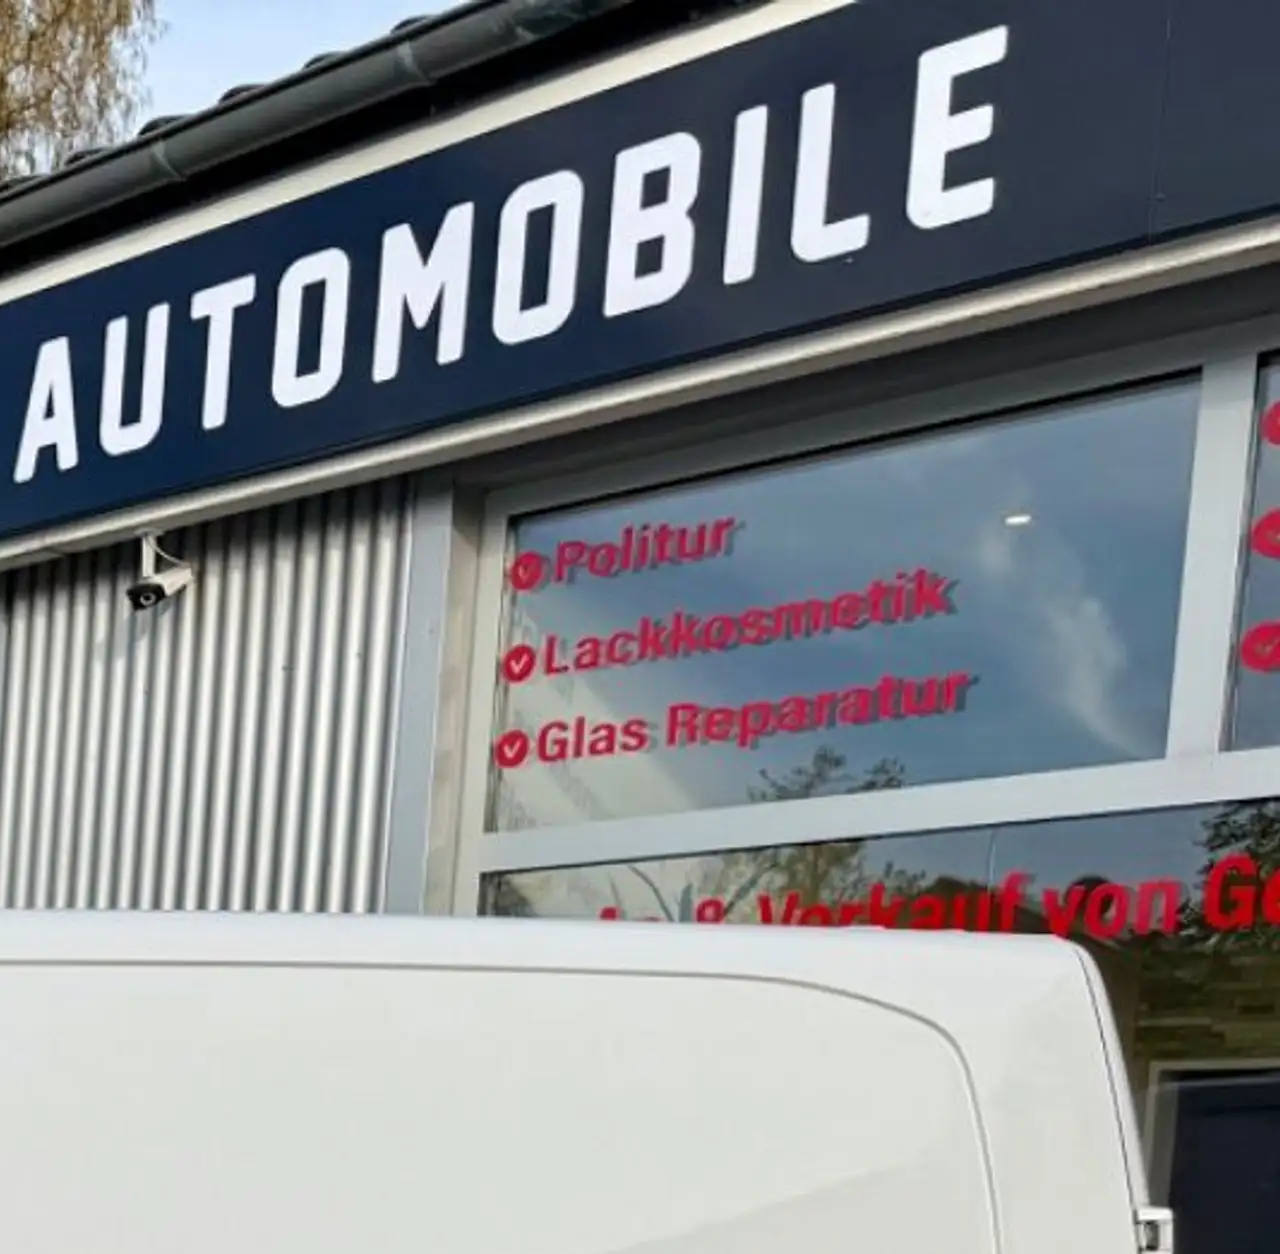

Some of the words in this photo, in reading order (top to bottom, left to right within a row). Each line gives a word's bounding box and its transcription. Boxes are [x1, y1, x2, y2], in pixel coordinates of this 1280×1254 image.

[13, 25, 1009, 484] AUTOMOBILE
[551, 515, 737, 586] Politur
[542, 567, 954, 678] Lackkosmetik
[535, 713, 648, 765] Glas
[665, 673, 970, 752] Reparatur
[1042, 875, 1183, 942] von
